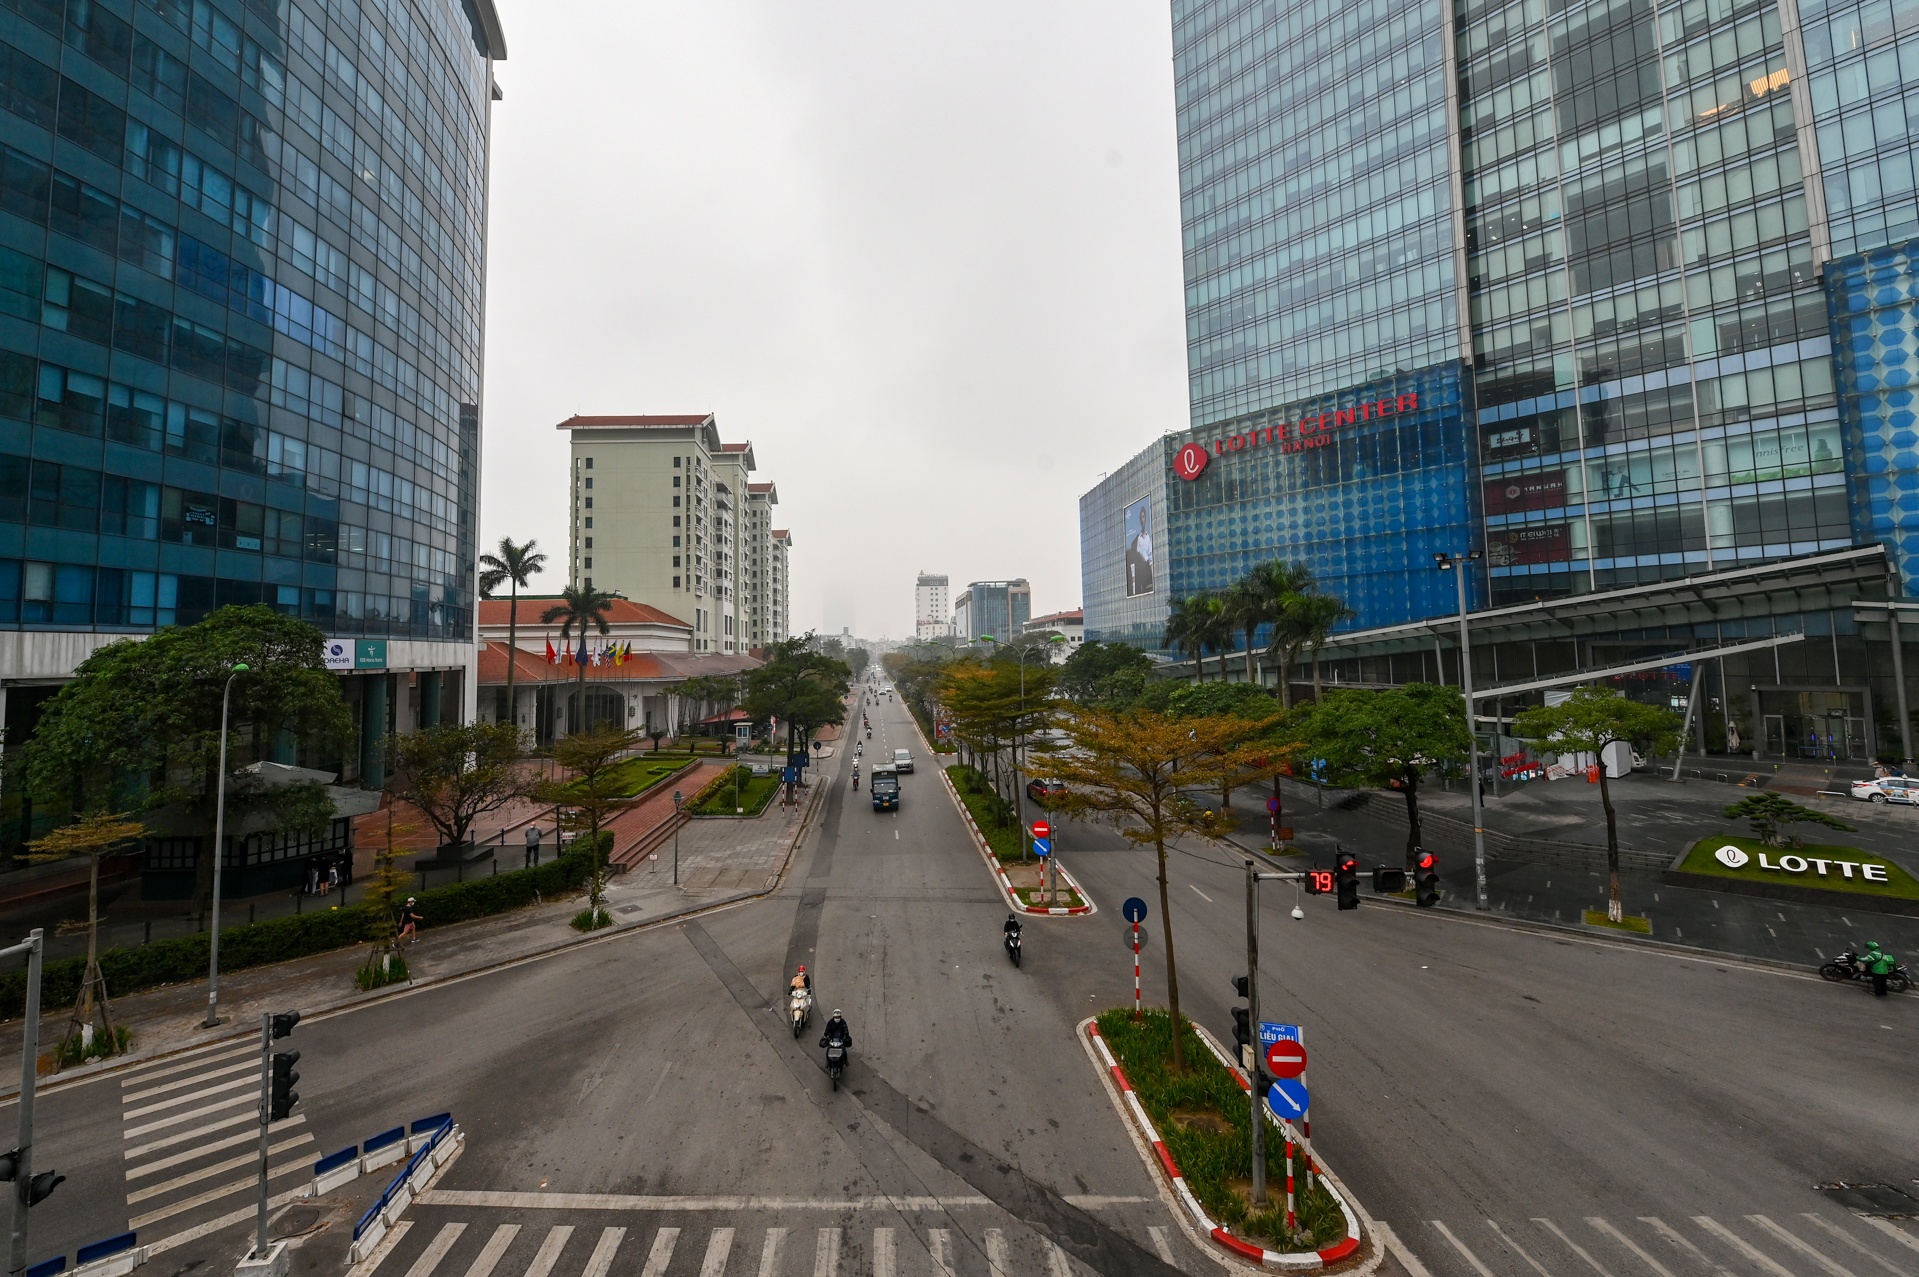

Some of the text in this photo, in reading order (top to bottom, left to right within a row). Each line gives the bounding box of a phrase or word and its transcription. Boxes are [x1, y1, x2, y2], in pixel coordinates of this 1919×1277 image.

[1215, 393, 1418, 454] LOTTE CENTER
[1281, 434, 1331, 454] HANOI
[1755, 444, 1804, 458] nnisfree
[1758, 853, 1888, 882] LOTTE
[1310, 872, 1331, 892] 79
